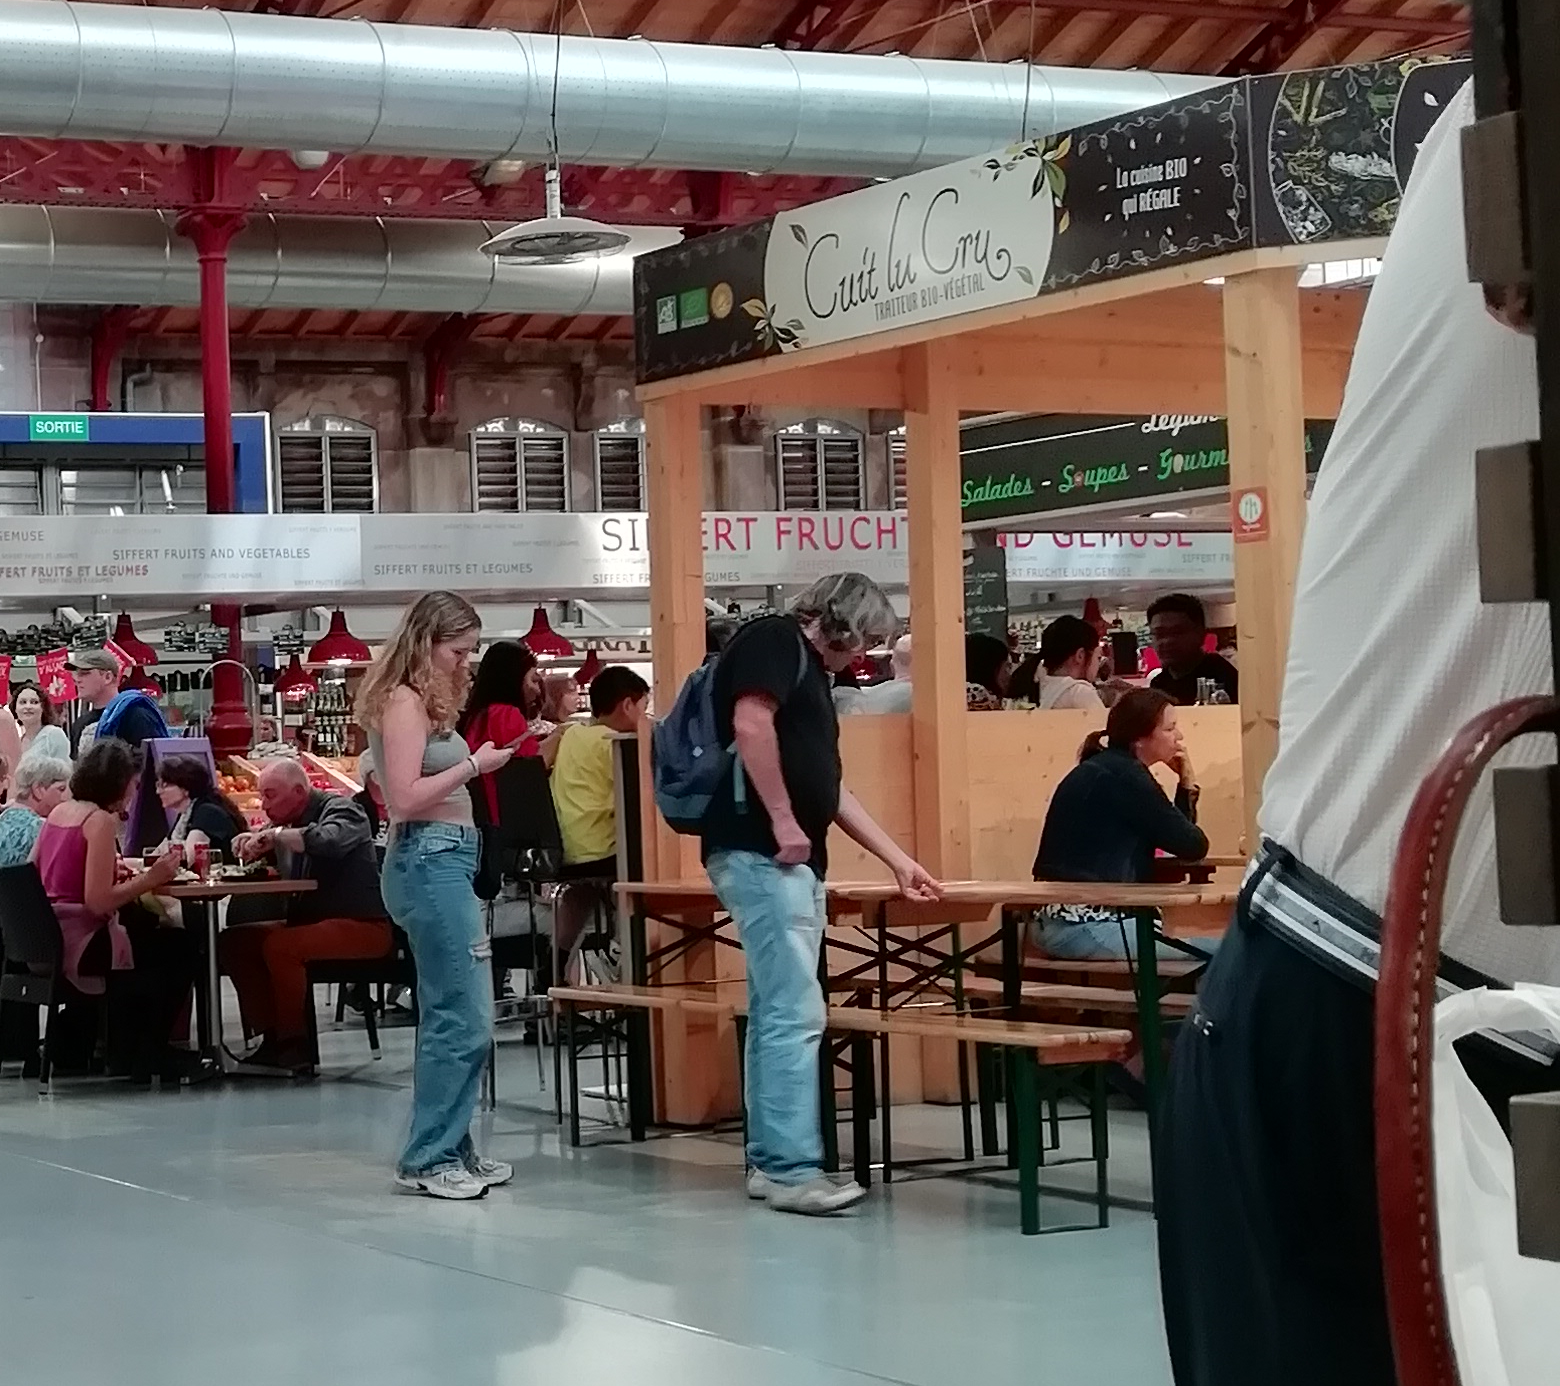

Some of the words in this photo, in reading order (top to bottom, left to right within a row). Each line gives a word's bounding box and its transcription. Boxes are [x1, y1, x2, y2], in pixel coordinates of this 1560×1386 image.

[1165, 157, 1188, 180] BIO
[1139, 187, 1181, 212] RÉGALE
[805, 233, 879, 319] Cuit
[922, 188, 1011, 281] Cru
[874, 297, 919, 322] TRAITEUR
[921, 274, 985, 309] BIO-VÉGÉTAL
[35, 421, 84, 433] SORTIE
[961, 475, 1035, 507] Salades
[1058, 464, 1131, 493] Soupes
[1157, 447, 1229, 480] Gourm
[776, 517, 908, 551] FRUCH
[113, 549, 159, 561] SIFFERT
[164, 548, 206, 560] FRUITS
[210, 547, 235, 559] AND
[238, 547, 311, 559] VEGETABLES
[31, 566, 73, 578] FRUITS
[77, 565, 92, 577] ET
[95, 564, 149, 577] LEGUMES
[374, 564, 418, 575] SIFFERT
[422, 563, 462, 575] FRUITS
[465, 563, 478, 574] ET
[483, 562, 533, 574] LEGUMES
[593, 573, 636, 584] SIFFERT
[705, 571, 740, 582] GUMES
[1027, 567, 1068, 578] FRUCHTE
[1072, 567, 1091, 577] UND
[1095, 567, 1132, 577] GEMUSE
